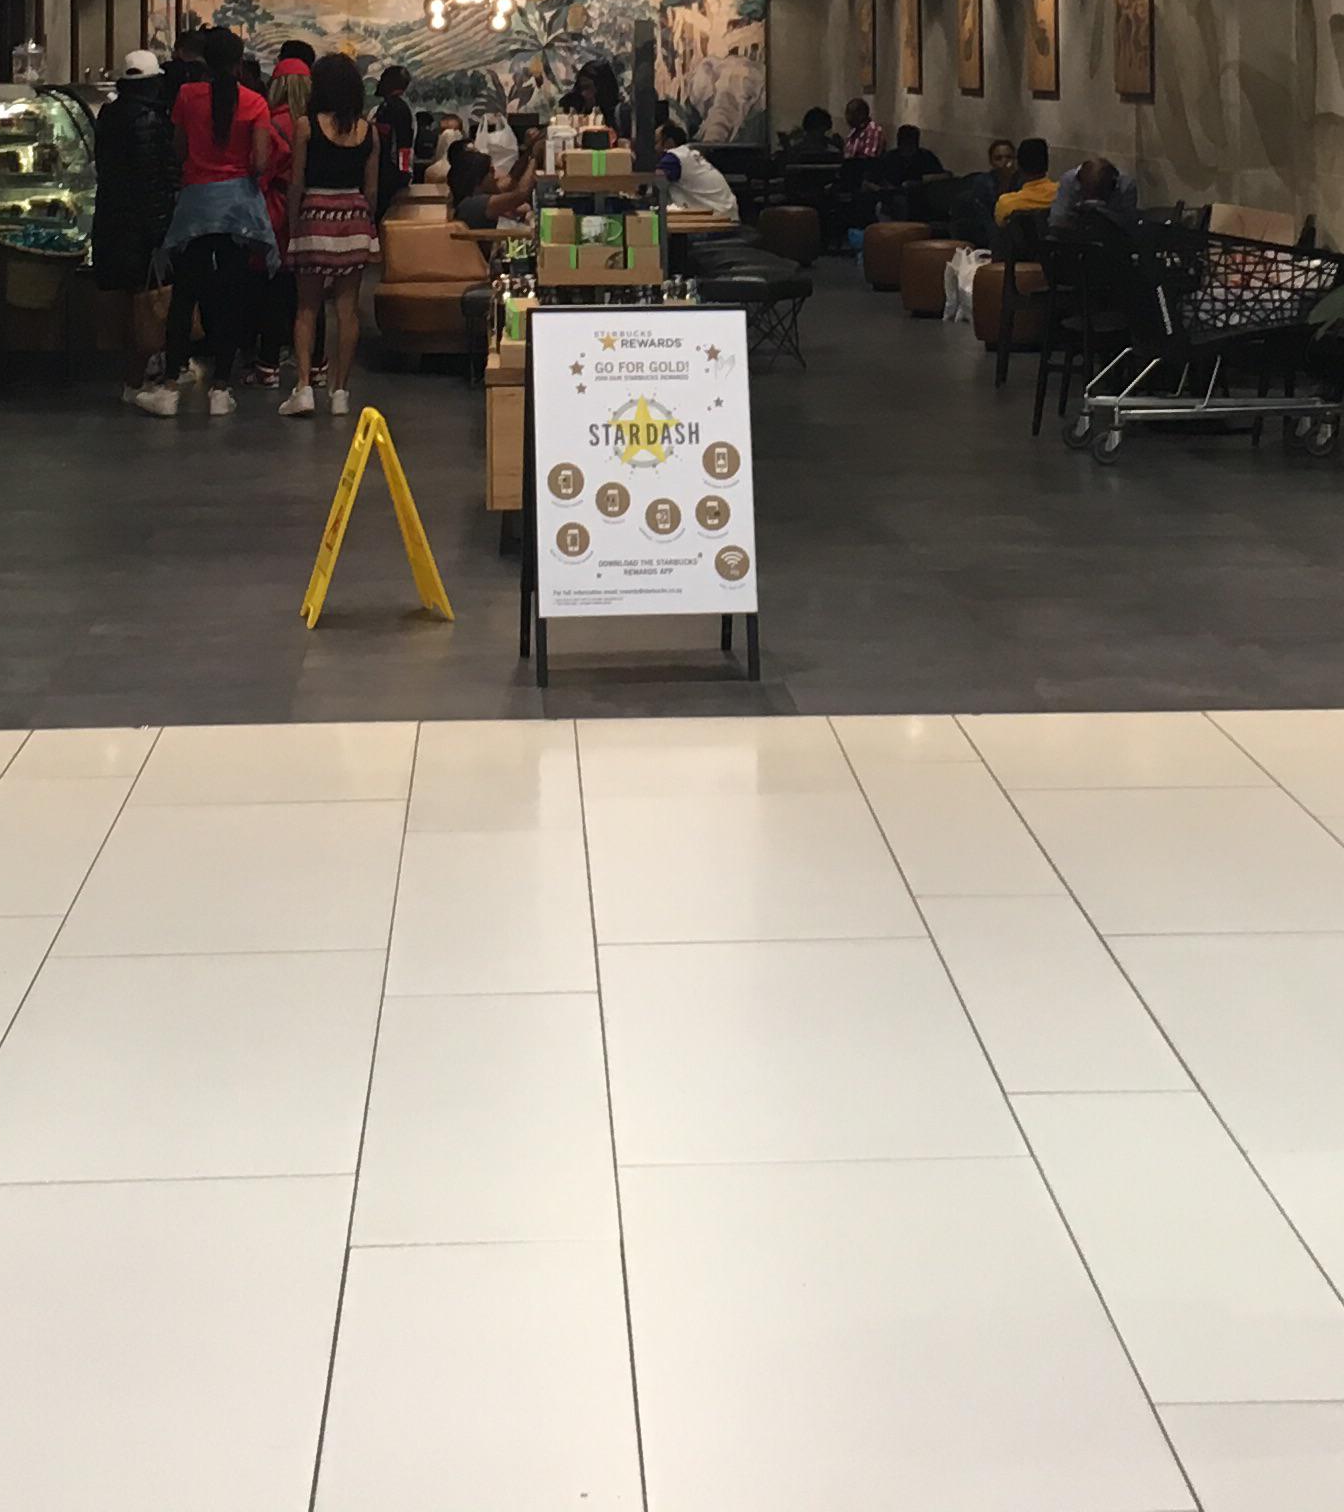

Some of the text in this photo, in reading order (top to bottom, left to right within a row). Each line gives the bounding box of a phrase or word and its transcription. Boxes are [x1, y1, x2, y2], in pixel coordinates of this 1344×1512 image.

[621, 338, 682, 348] REWARDS
[595, 360, 689, 373] GO FOR GOLD!
[656, 558, 698, 566] STARBUCKS
